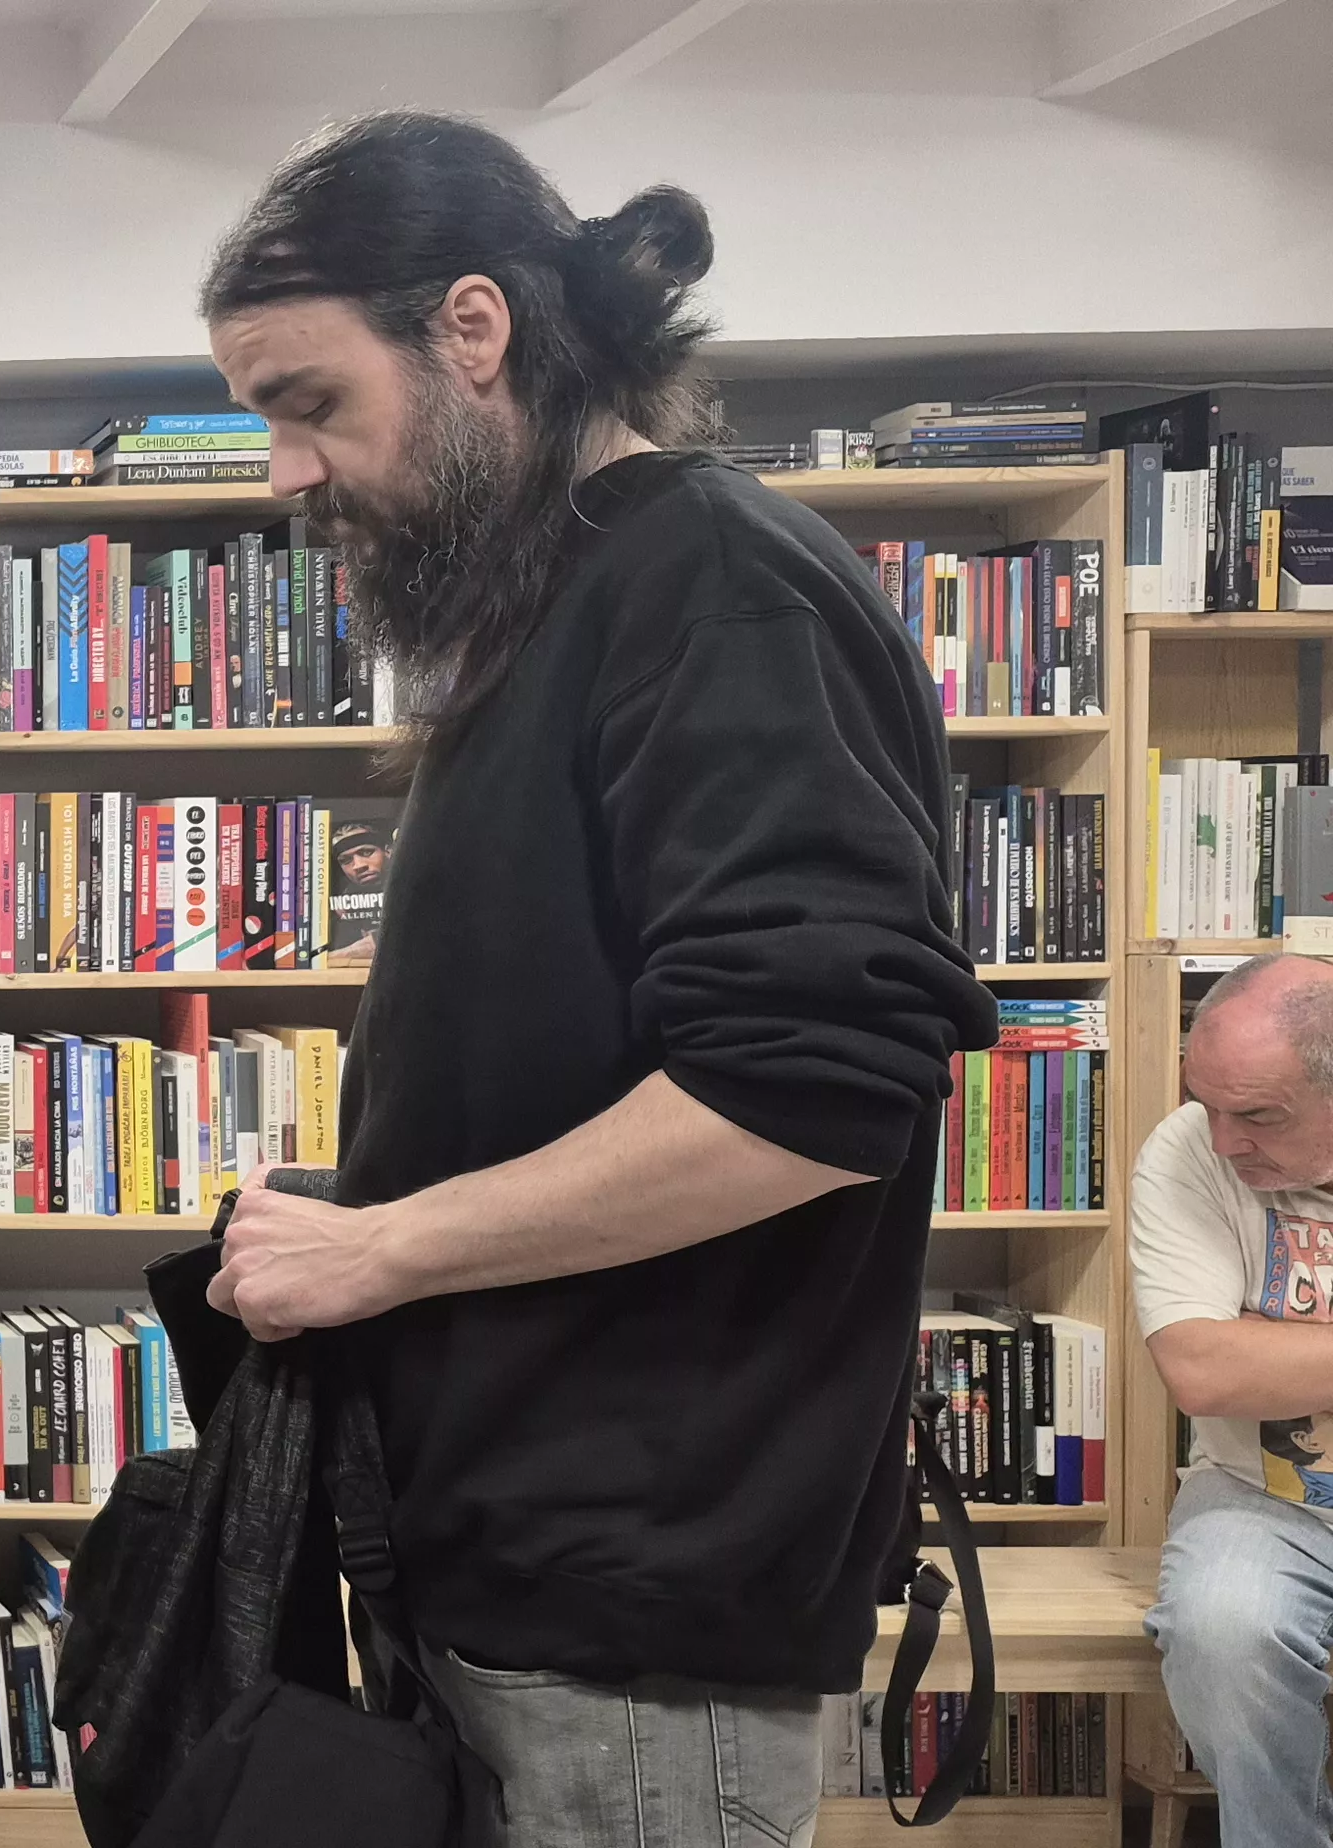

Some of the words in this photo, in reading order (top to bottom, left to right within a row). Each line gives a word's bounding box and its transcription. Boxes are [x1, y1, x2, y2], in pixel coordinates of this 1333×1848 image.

[135, 435, 216, 449] GHIBLIOTECA
[127, 465, 156, 480] Lena
[158, 465, 206, 480] Dunham
[212, 463, 262, 478] Famesick
[247, 549, 256, 617] CHRISTOPHER
[292, 549, 305, 585] David
[315, 554, 325, 607] NEWMAN
[1078, 551, 1099, 597] POE
[177, 575, 189, 635] Videoclub
[292, 587, 305, 614] Lynch
[248, 619, 256, 654] NOLAN
[315, 608, 325, 638] PAUL
[92, 641, 105, 683] DIRECTED
[64, 804, 72, 824] 101
[64, 827, 72, 891] HISTORIAS
[124, 843, 132, 892] OUTSIDER
[318, 853, 325, 865] TO
[17, 861, 26, 904] ROBADOS
[17, 905, 26, 940] SUEÑOS
[63, 894, 72, 918] NBA
[340, 911, 374, 920] ALLEN
[69, 1046, 79, 1094] MONTAÑAS
[71, 1095, 79, 1111] MIS
[141, 1089, 149, 1115] BORG
[141, 1118, 150, 1148] BJÖRN
[52, 1338, 66, 1377] COHEN
[73, 1333, 83, 1357] OZZY
[74, 1358, 85, 1412] OSBOURNE
[53, 1379, 68, 1432] LEONARD
